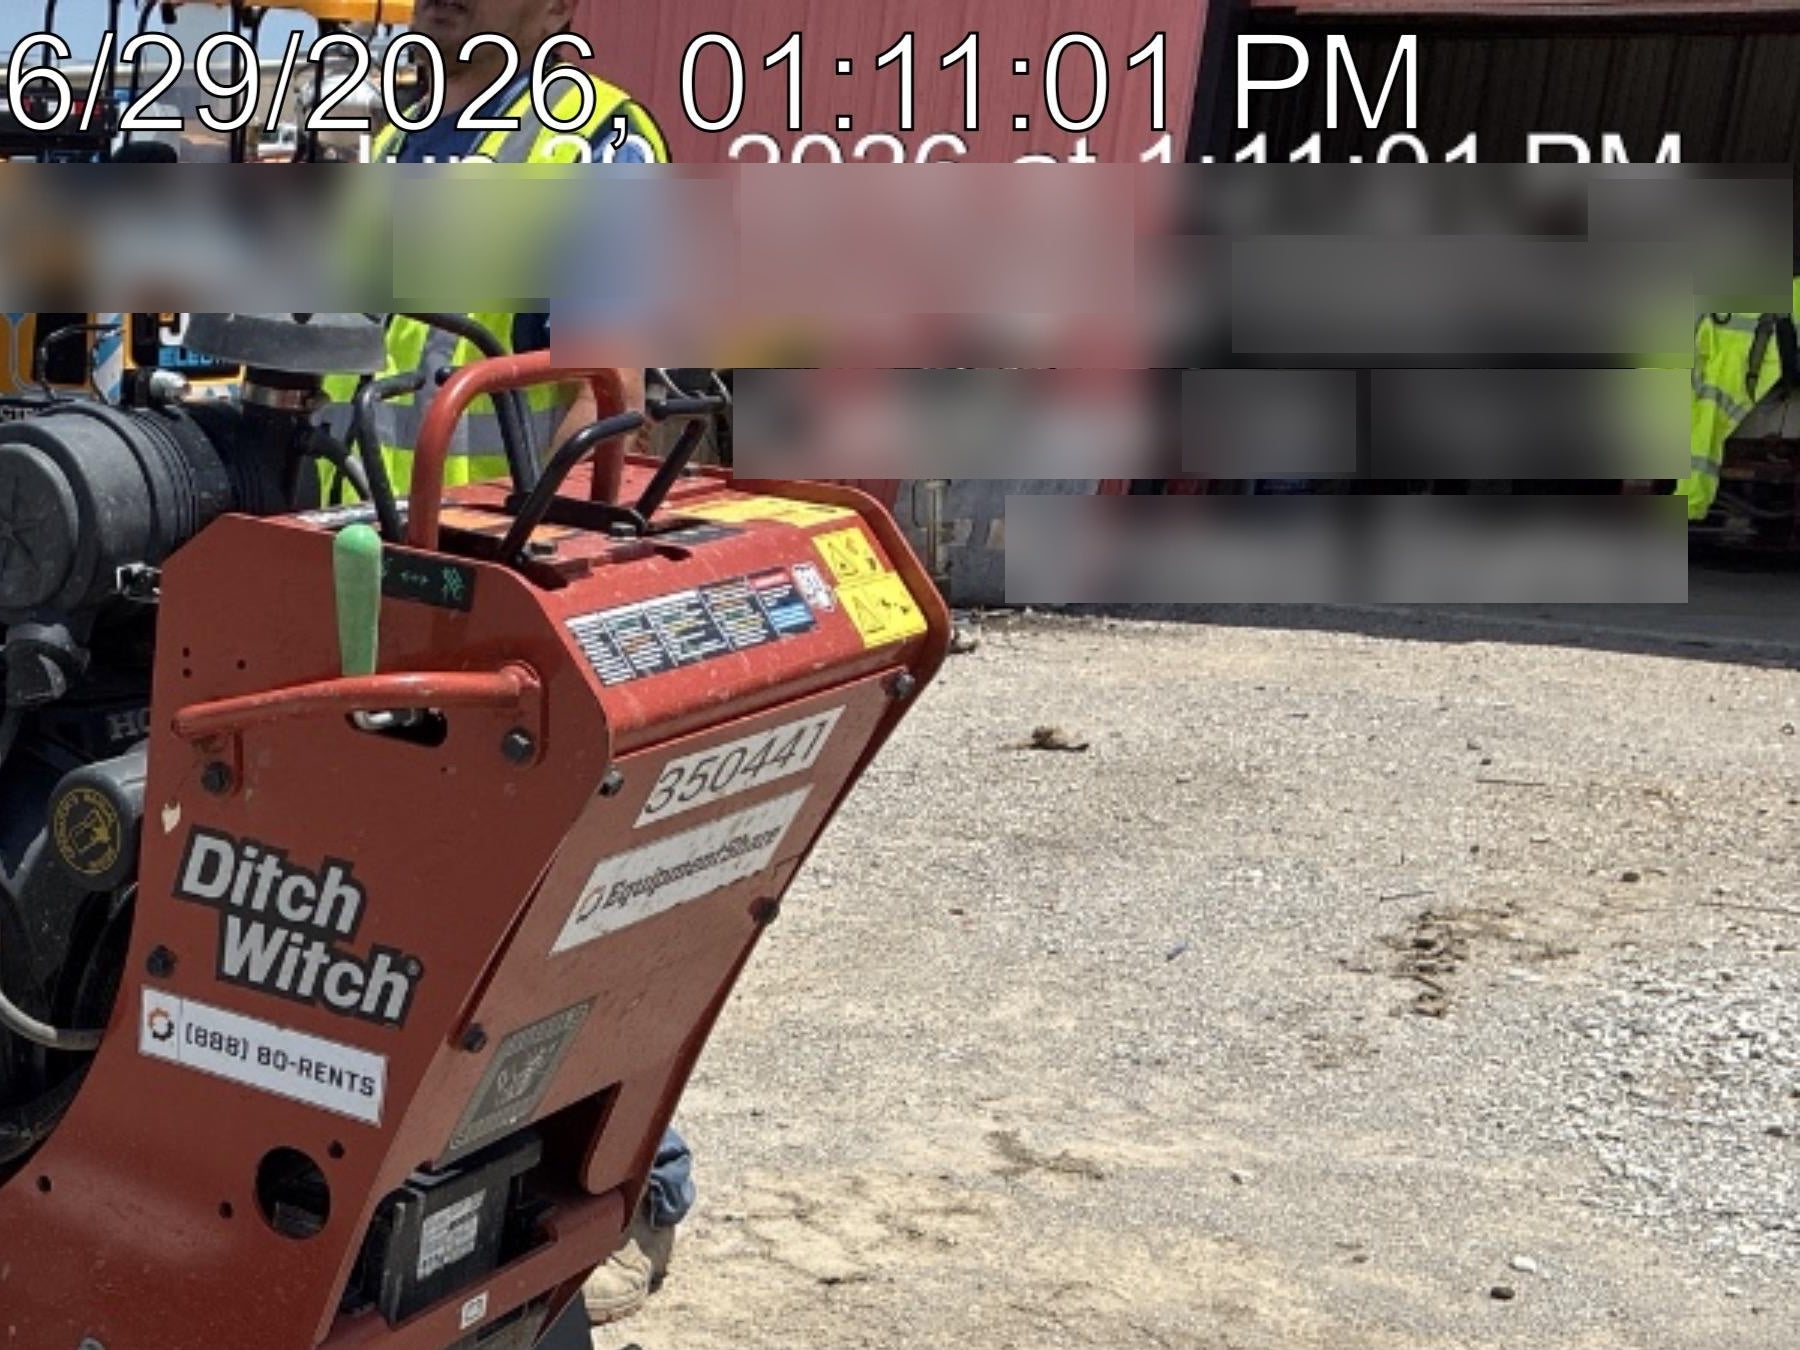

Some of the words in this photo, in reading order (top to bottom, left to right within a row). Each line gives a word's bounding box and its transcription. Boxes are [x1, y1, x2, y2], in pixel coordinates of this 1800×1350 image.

[645, 719, 829, 813] 350441
[181, 832, 362, 934] Ditch
[185, 1022, 248, 1061] (888)
[257, 1046, 376, 1097] 80-RENTS
